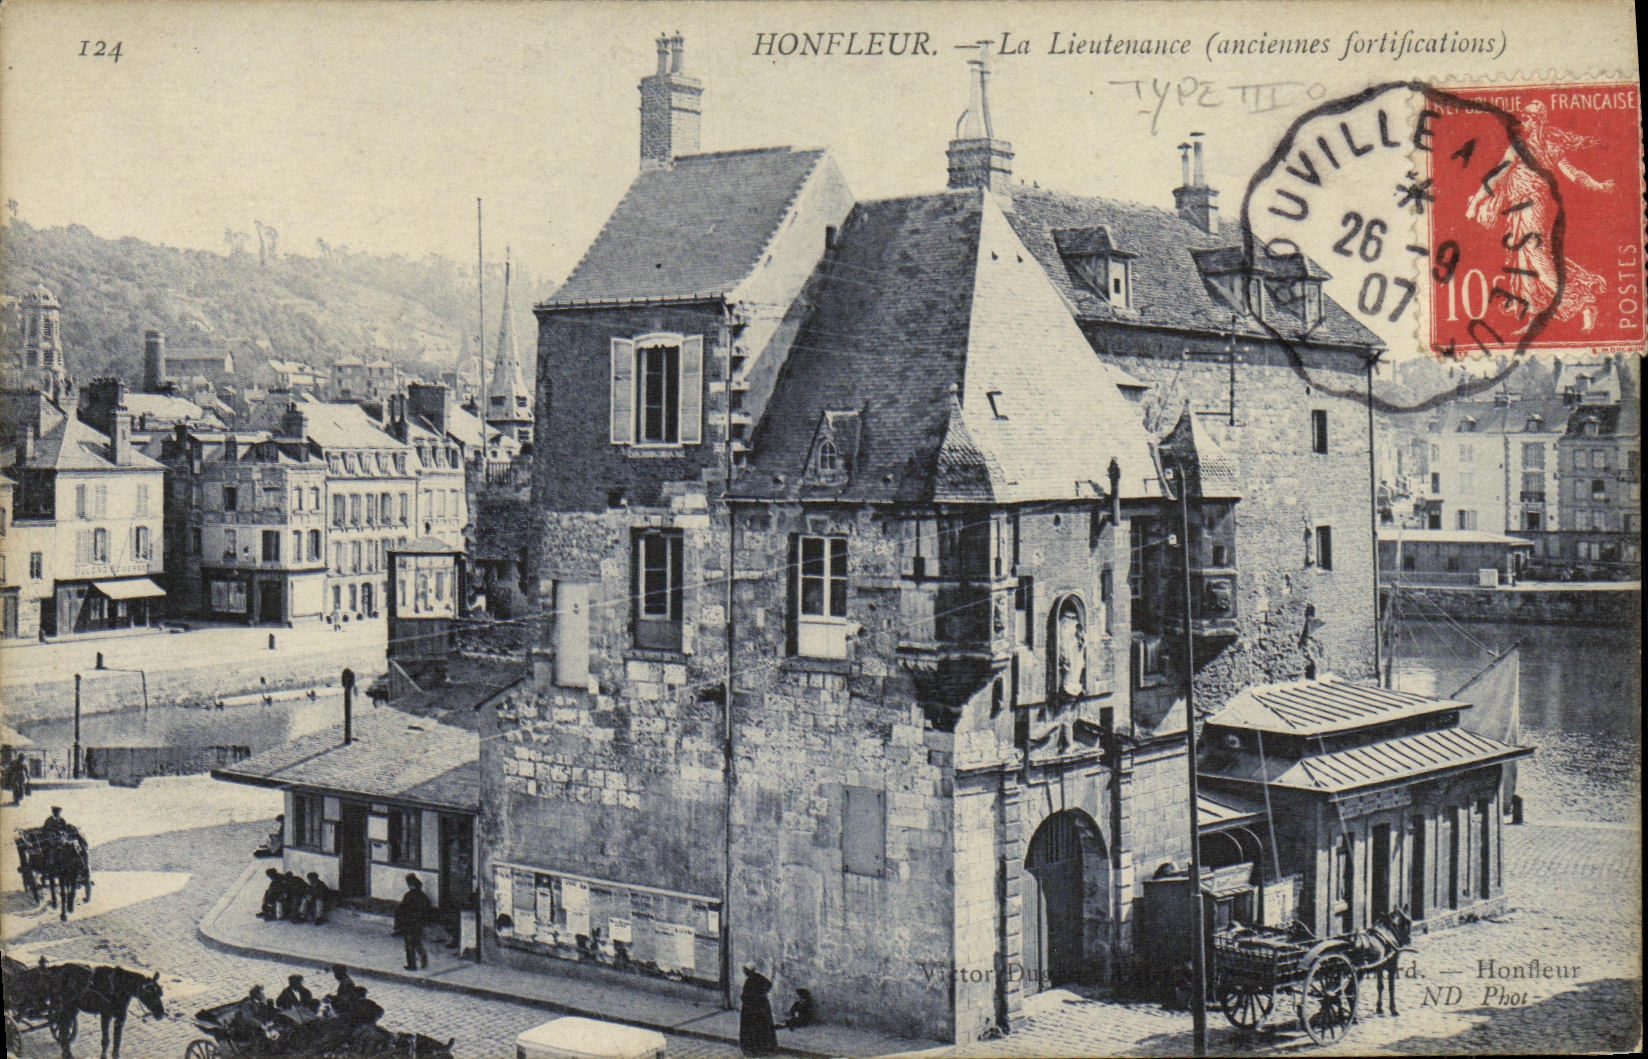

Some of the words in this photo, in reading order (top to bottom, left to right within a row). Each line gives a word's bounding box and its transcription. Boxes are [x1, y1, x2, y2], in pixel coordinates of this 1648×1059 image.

[1551, 91, 1636, 113] FRANÇAISE
[1333, 212, 1387, 263] 26
[1358, 273, 1417, 323] 07
[1618, 244, 1638, 329] POSTES
